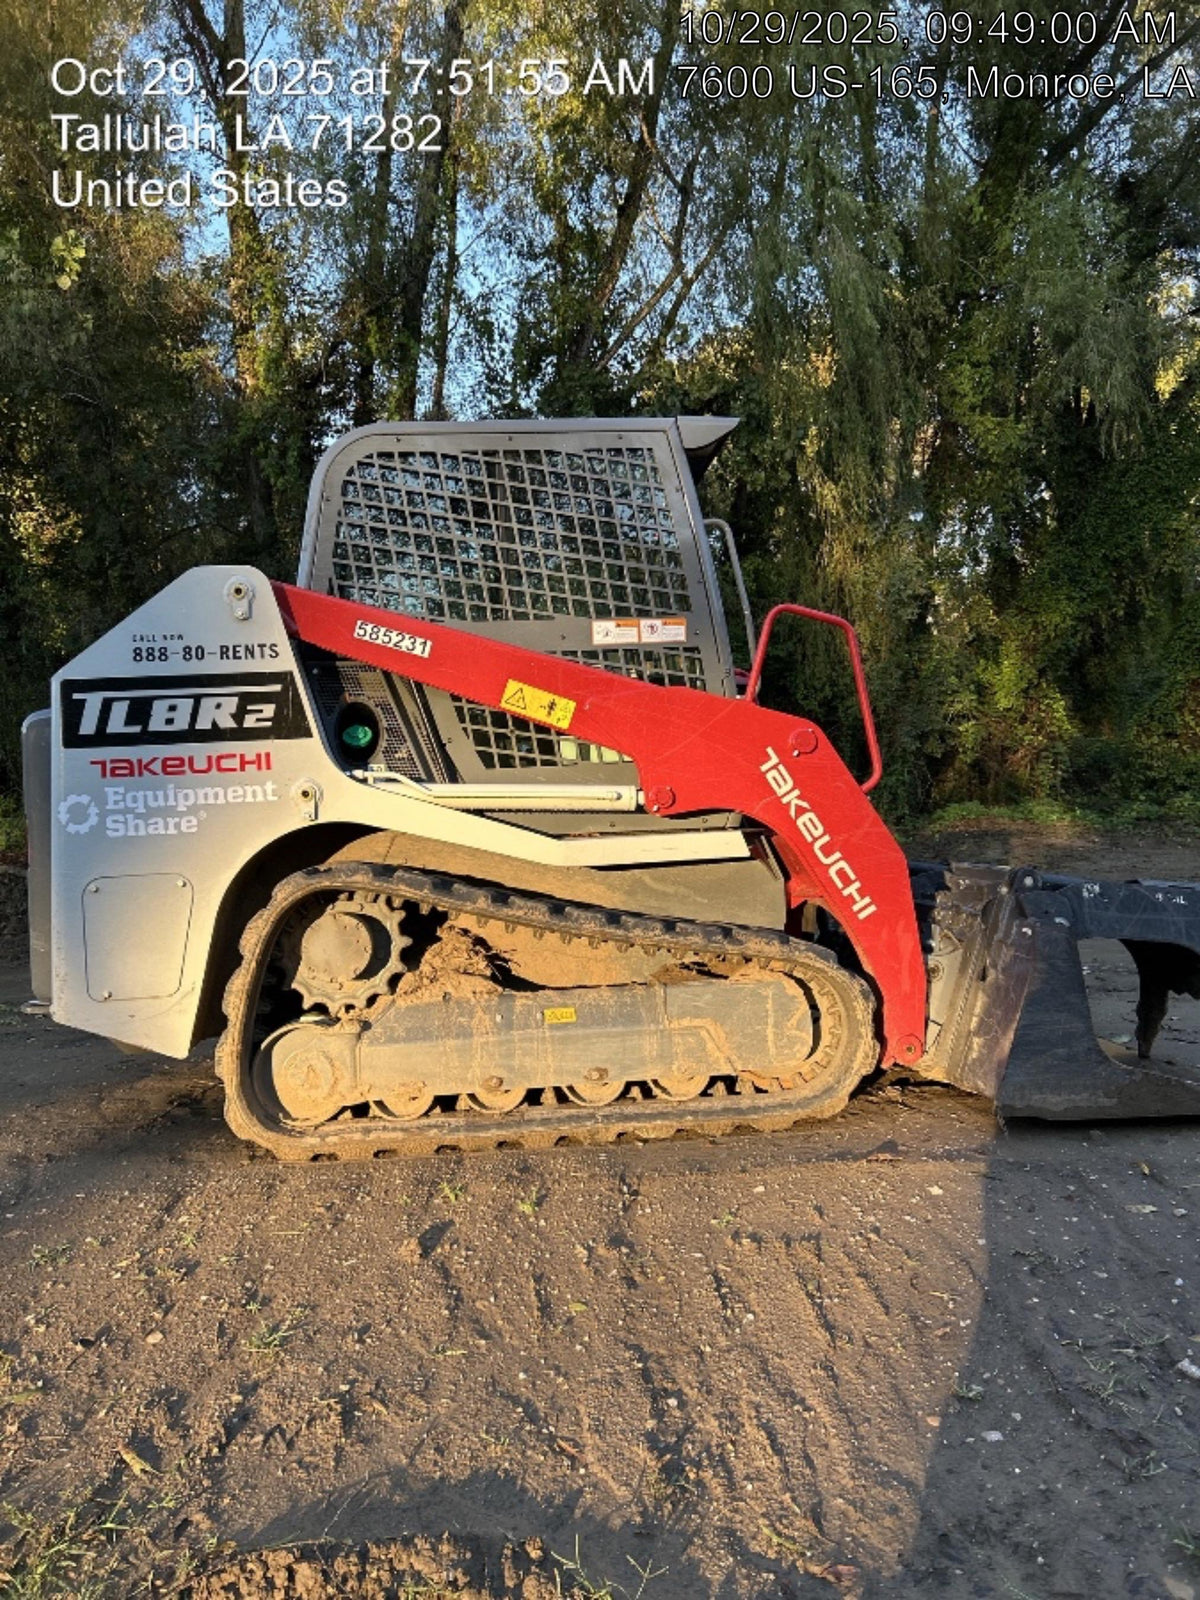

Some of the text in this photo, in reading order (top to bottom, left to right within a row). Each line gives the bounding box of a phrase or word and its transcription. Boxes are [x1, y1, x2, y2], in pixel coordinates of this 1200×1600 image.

[132, 643, 280, 662] 888-80-RENTS
[356, 622, 428, 655] 585231
[104, 781, 278, 812] Equipment
